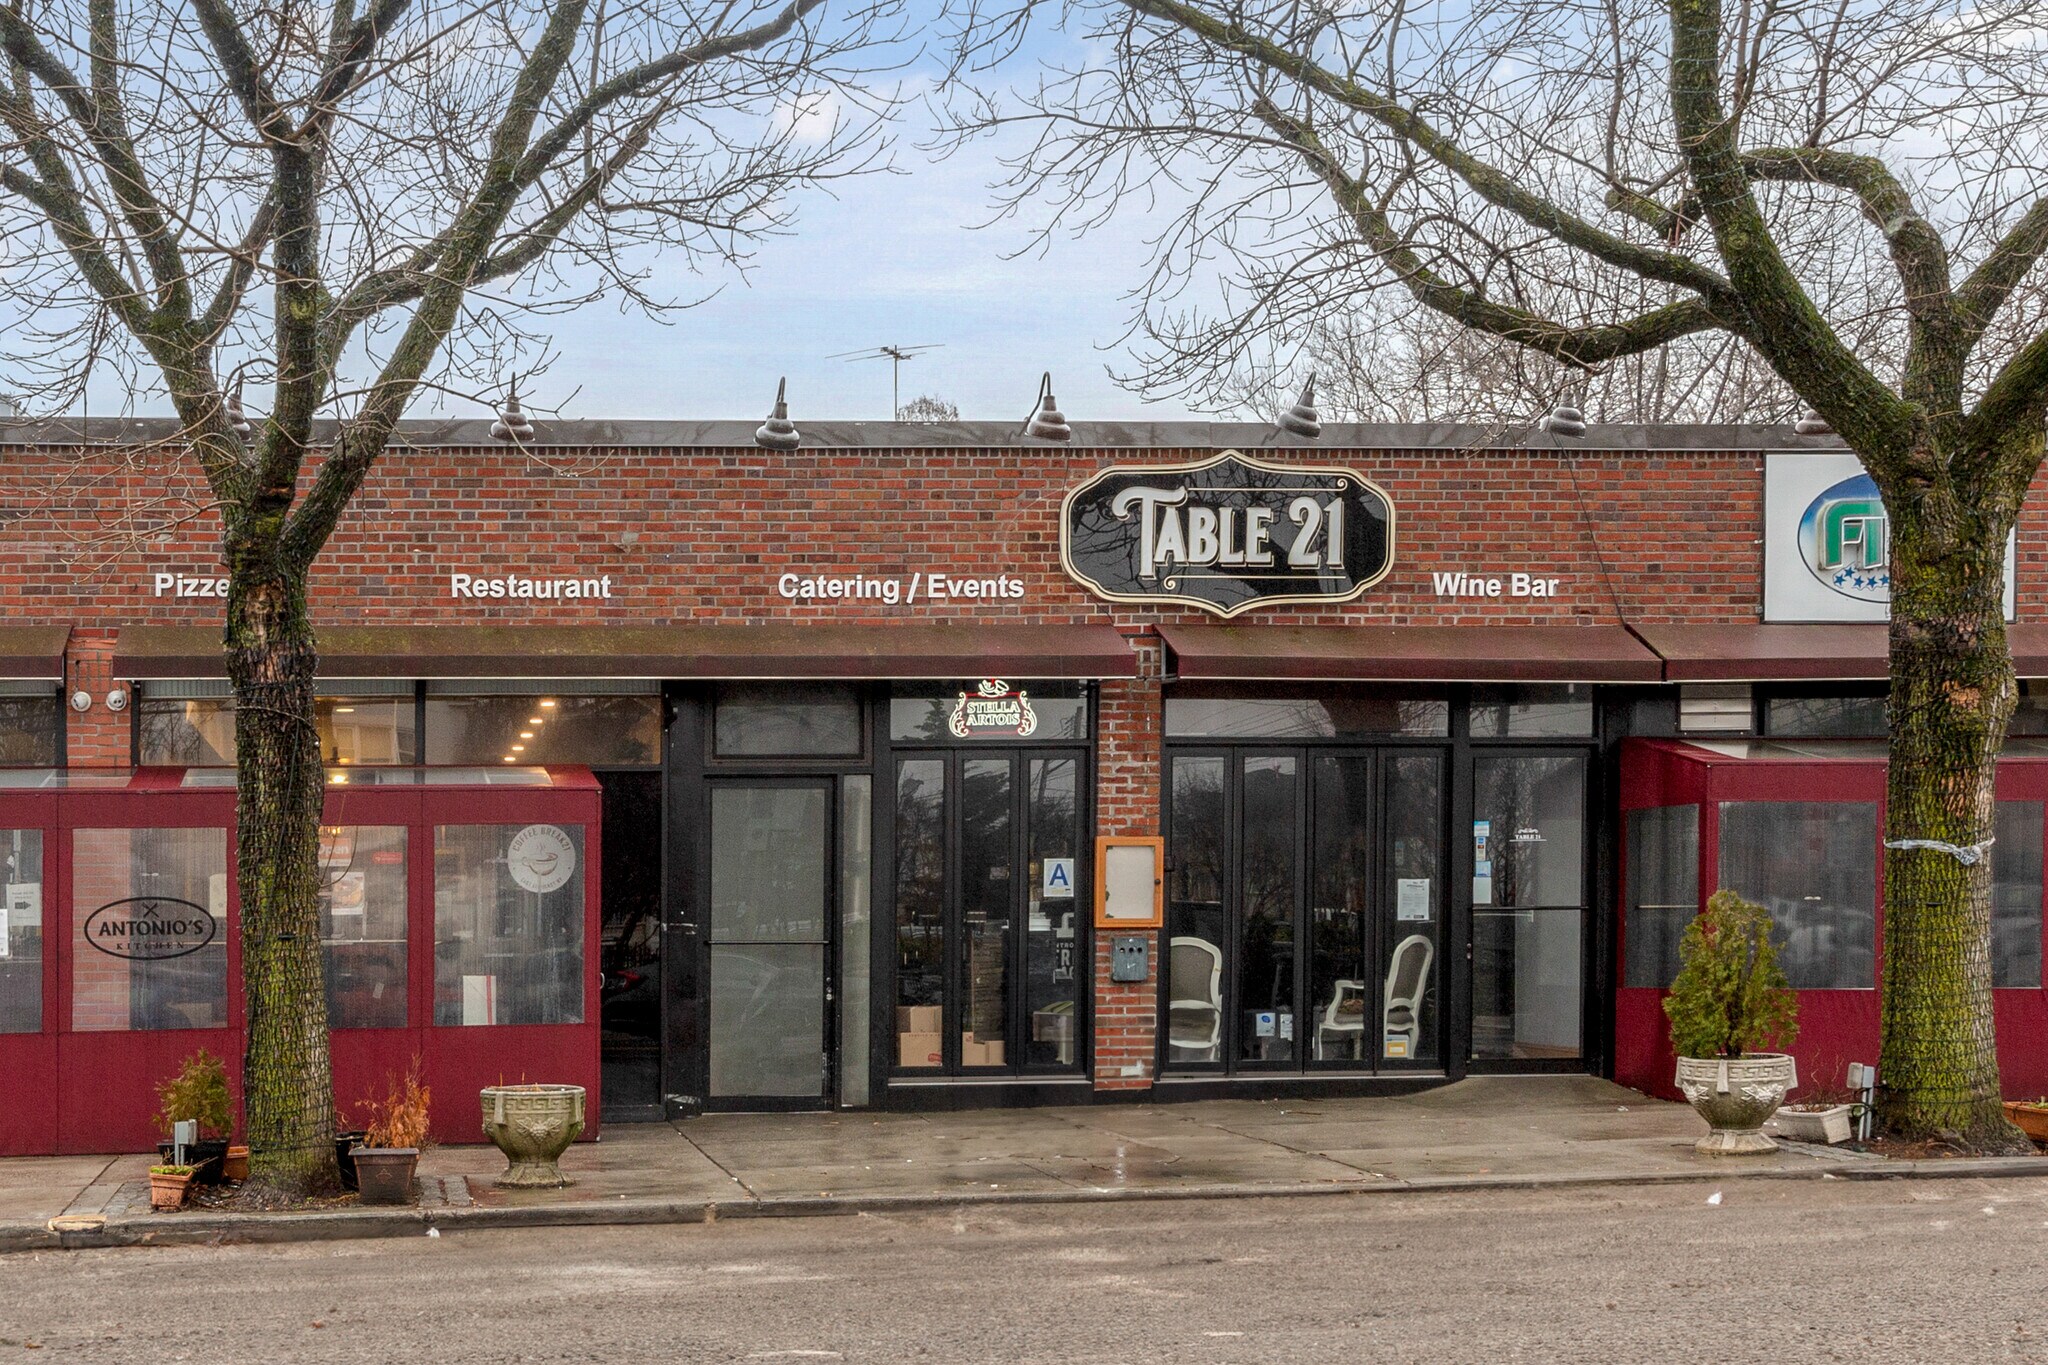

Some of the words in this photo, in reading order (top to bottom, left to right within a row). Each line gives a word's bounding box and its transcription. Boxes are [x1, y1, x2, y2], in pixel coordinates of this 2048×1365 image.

[1112, 486, 1274, 579] TABLE
[1288, 496, 1345, 570] 21
[155, 573, 231, 597] Pizze
[451, 573, 612, 598] Restaurant
[778, 573, 900, 604] Catering
[927, 574, 1025, 598] Events
[1433, 572, 1502, 597] Wine
[1511, 573, 1560, 597] Bar
[966, 701, 1021, 713] STELLA
[965, 713, 1021, 726] ARTOIS
[513, 827, 538, 852] COFFEE
[1049, 863, 1069, 886] A
[98, 919, 204, 937] ANTONIO'S
[116, 942, 185, 950] KITCHEN
